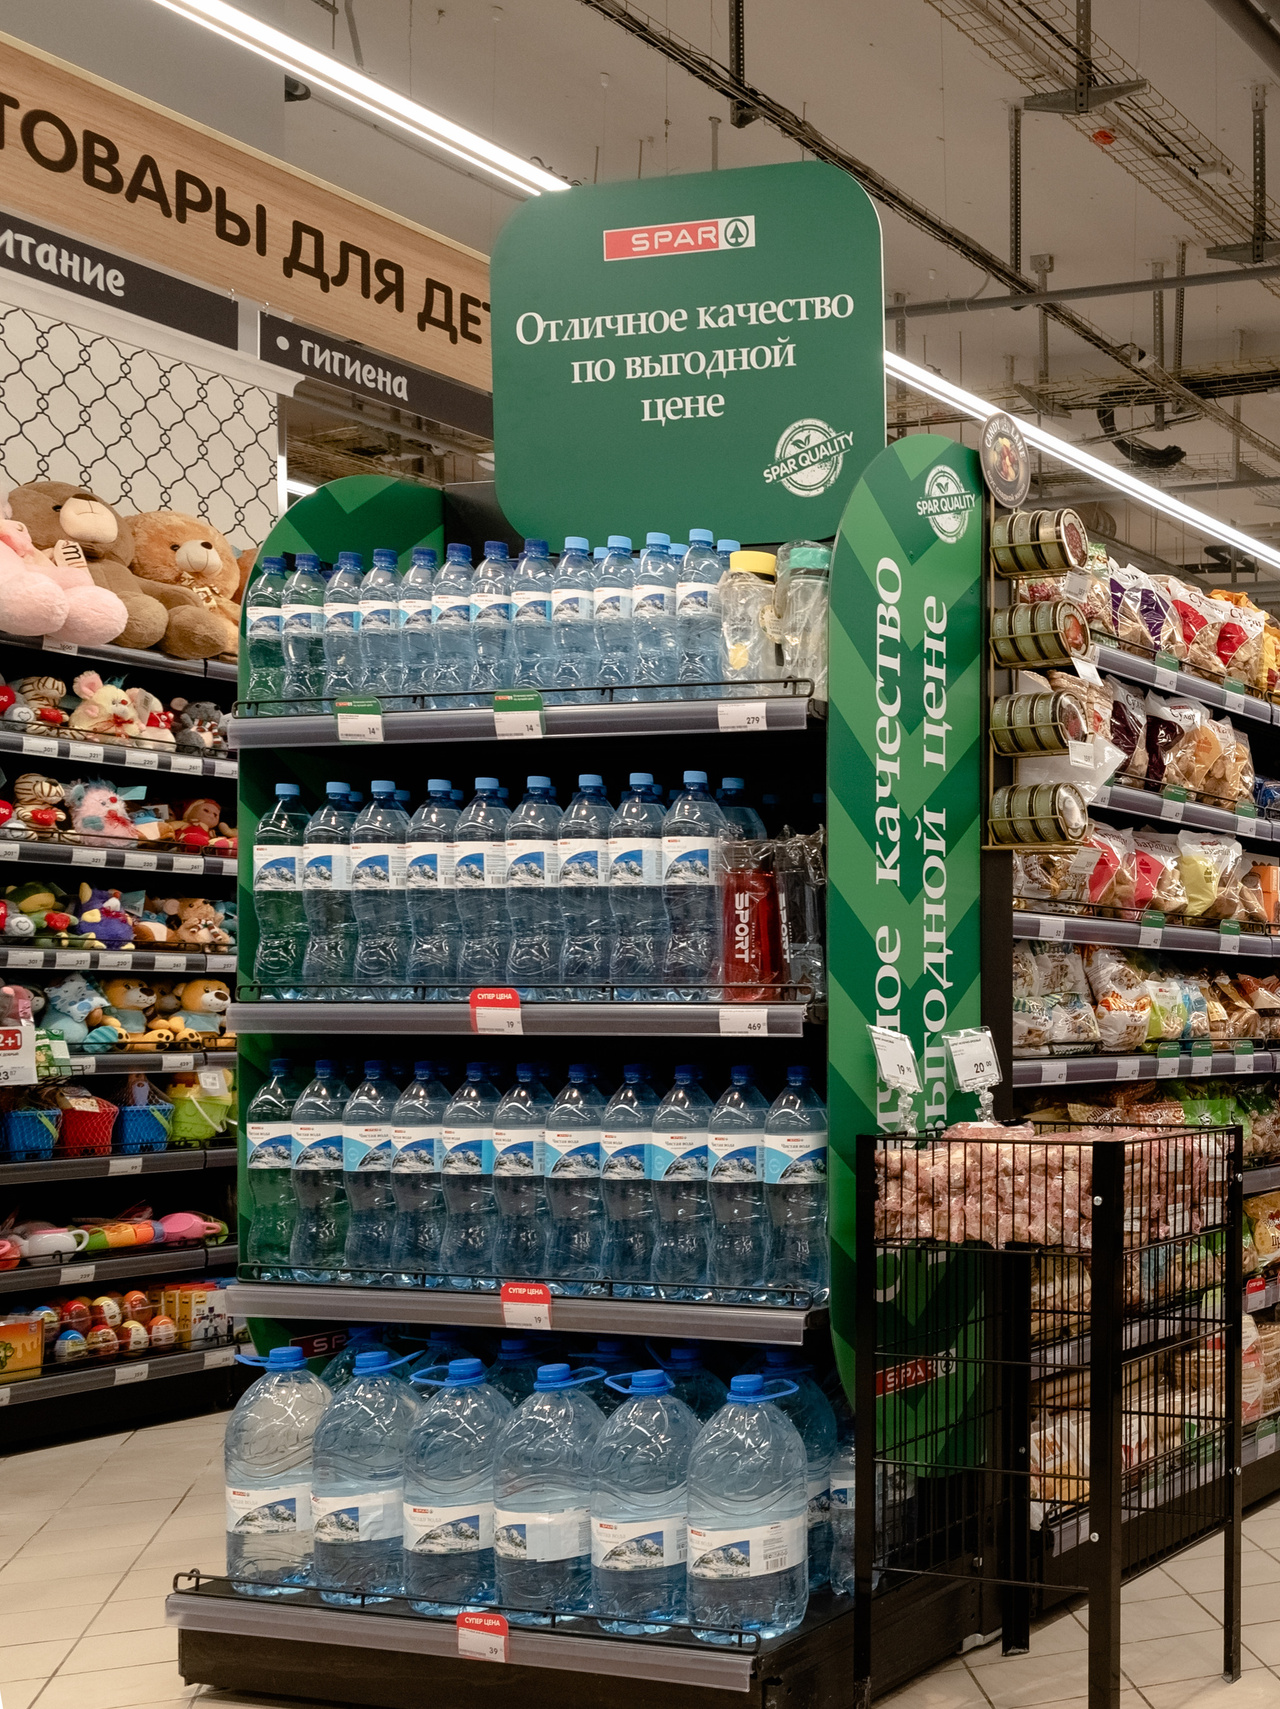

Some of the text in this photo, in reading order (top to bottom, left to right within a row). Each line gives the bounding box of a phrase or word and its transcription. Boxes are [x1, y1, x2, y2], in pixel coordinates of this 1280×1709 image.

[0, 94, 491, 345] ТОВАРЫ ДЛЯ ДЕ
[631, 221, 717, 252] SPAR
[515, 293, 855, 345] Отличное качество
[570, 337, 797, 384] по выгодной
[300, 338, 409, 402] гигиена
[640, 393, 725, 427] цене
[985, 419, 1000, 448] CANDY
[763, 431, 854, 485] SPAR QUALITY
[916, 494, 976, 516] SPAR QUALITY
[923, 595, 953, 772] цене
[525, 723, 535, 733] 14
[746, 716, 760, 725] 279
[875, 557, 902, 887] качество
[367, 726, 377, 735] 14
[735, 892, 749, 963] SPORT
[495, 992, 513, 1001] ЦЕНА
[505, 1020, 515, 1030] 19
[747, 1021, 762, 1031] 469
[897, 1064, 905, 1075] 19
[974, 1062, 984, 1074] 20
[508, 1286, 544, 1296] СУПЕР ЦЕНА
[534, 1316, 542, 1324] 19
[465, 1616, 500, 1627] СУПЕР ЦЕНА
[489, 1646, 499, 1656] 39
